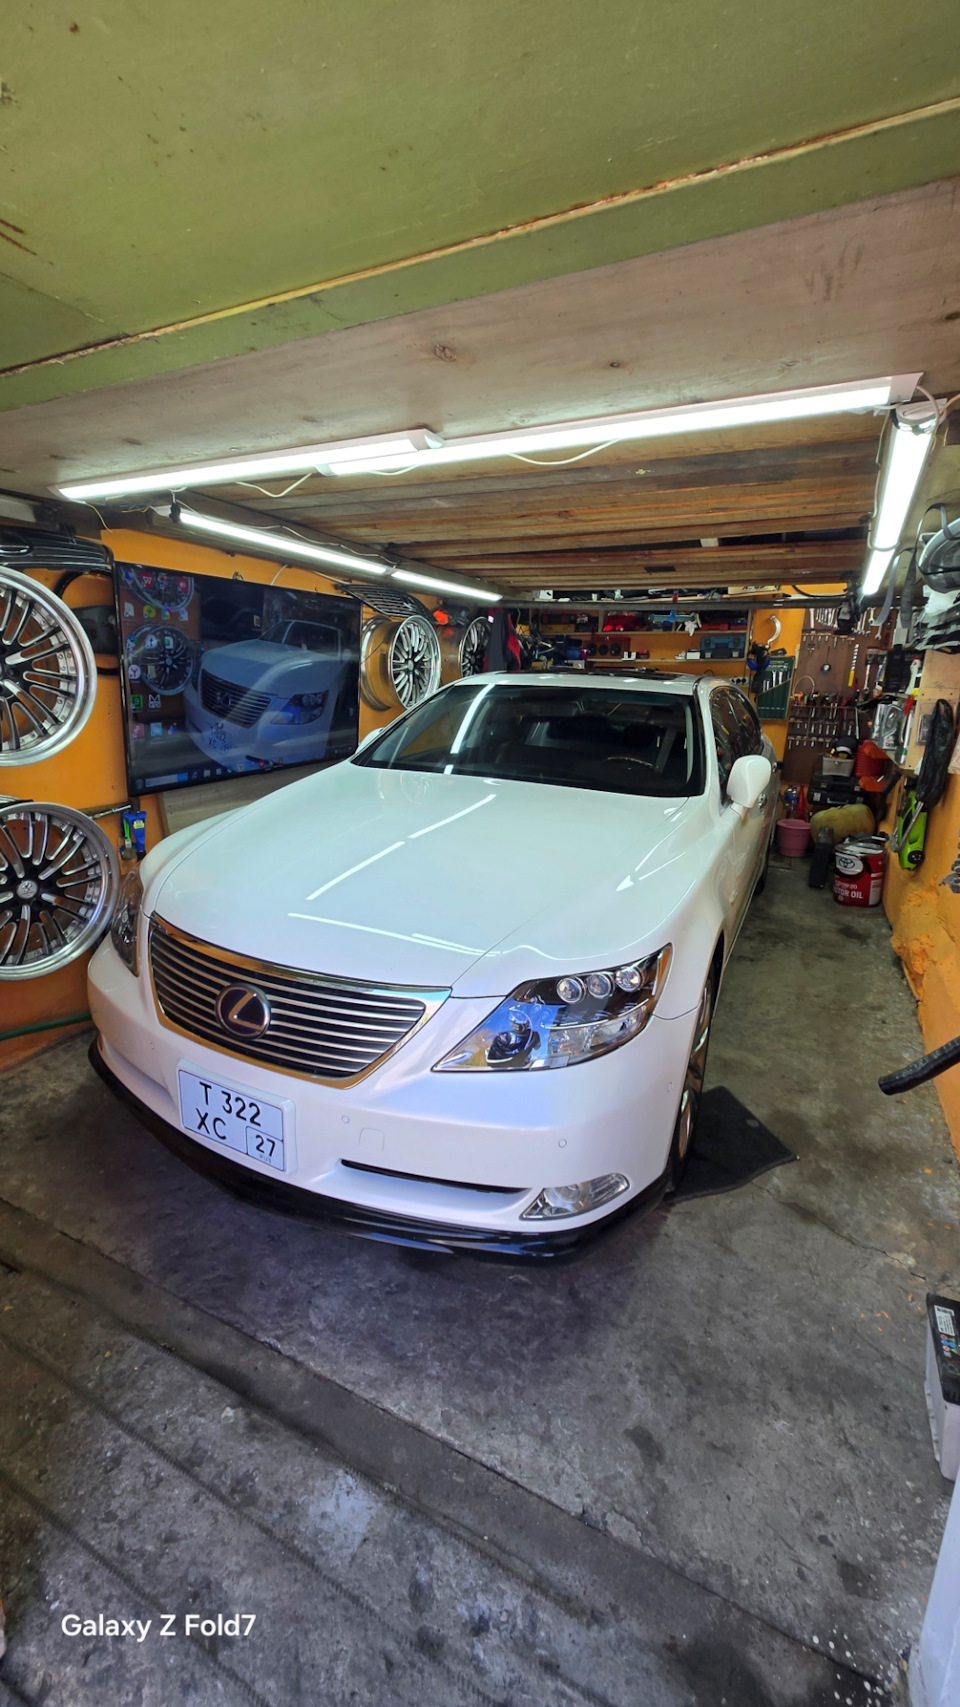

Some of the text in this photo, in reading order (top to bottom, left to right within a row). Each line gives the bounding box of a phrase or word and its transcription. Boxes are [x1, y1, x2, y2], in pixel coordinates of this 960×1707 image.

[850, 890, 864, 899] OIL
[199, 1081, 261, 1127] T 322
[195, 1107, 227, 1140] XC
[255, 1134, 276, 1157] 27
